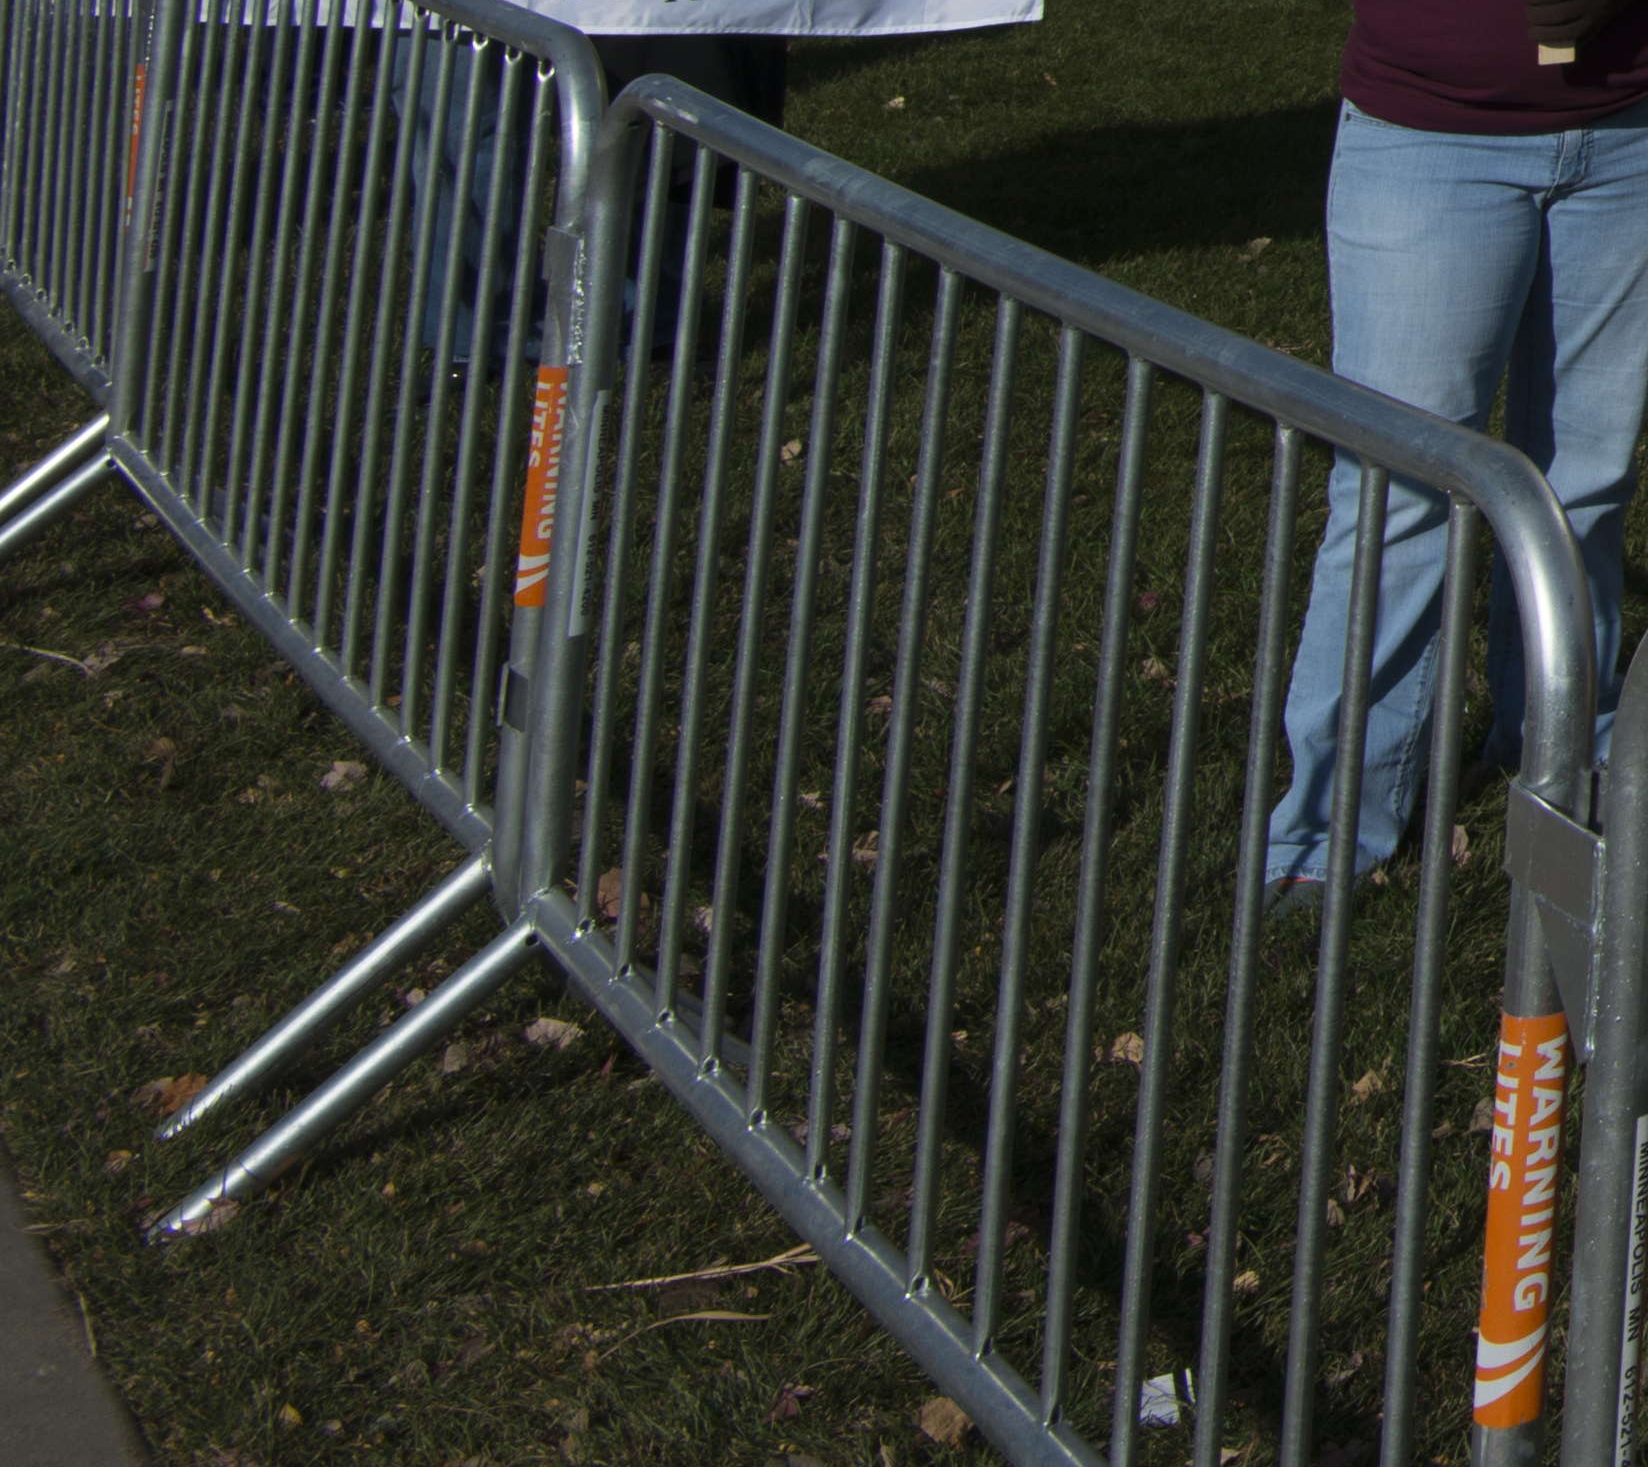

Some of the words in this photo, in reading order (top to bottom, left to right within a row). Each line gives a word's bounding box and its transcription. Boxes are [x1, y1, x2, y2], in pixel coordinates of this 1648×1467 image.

[590, 500, 600, 520] MN
[1489, 1040, 1523, 1191] LITES
[1514, 1032, 1568, 1312] WARNING
[1627, 1305, 1641, 1343] MN
